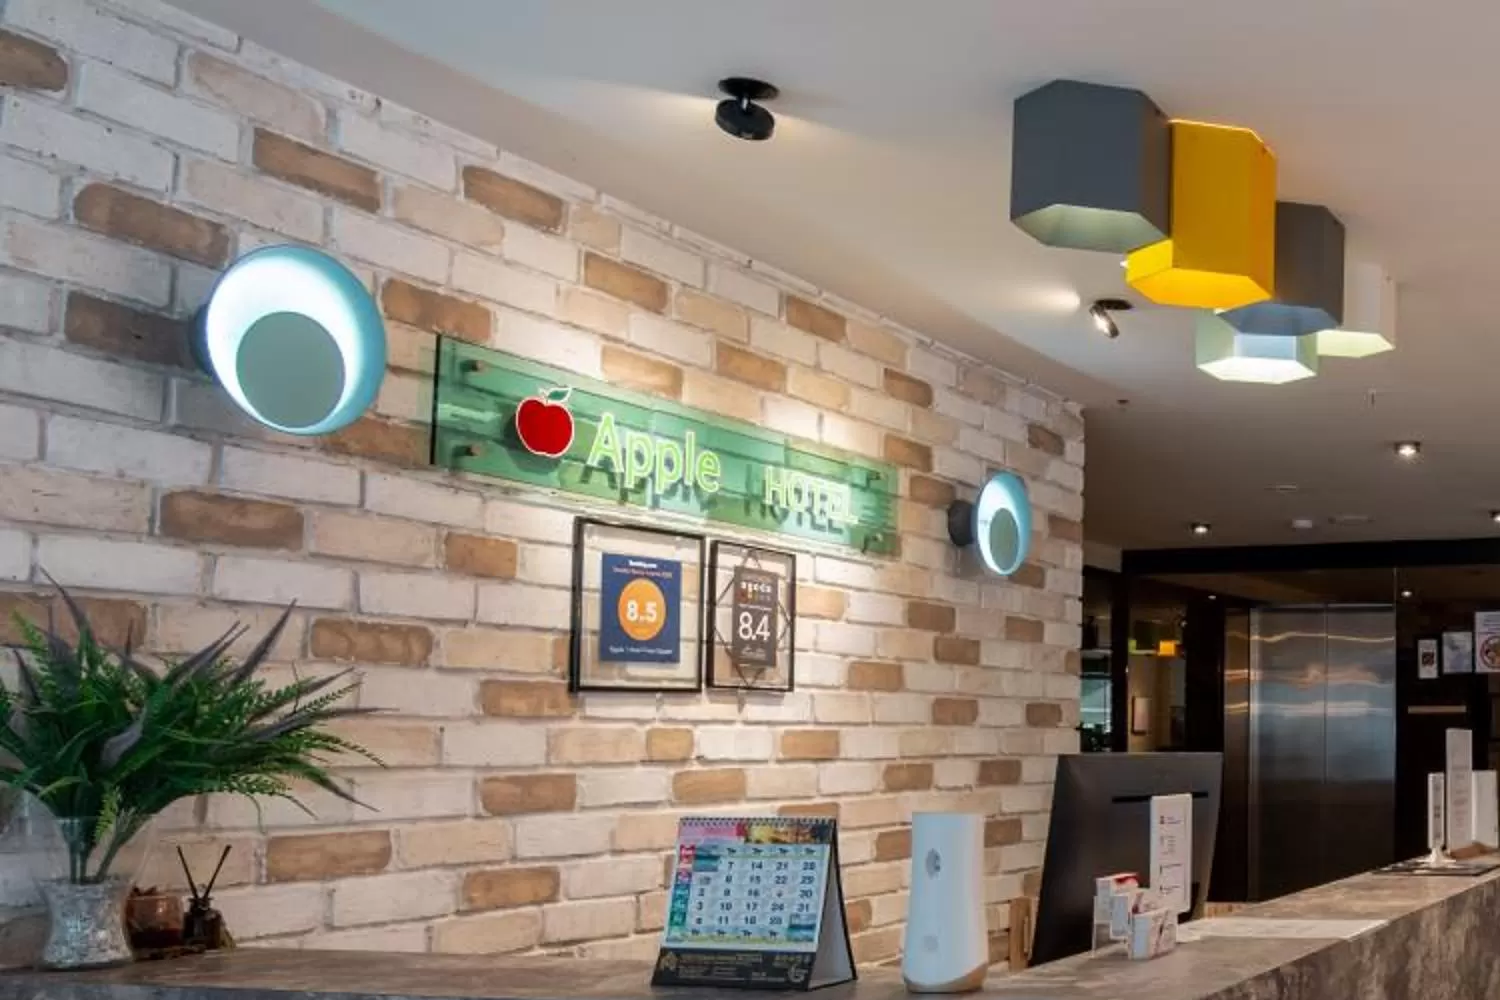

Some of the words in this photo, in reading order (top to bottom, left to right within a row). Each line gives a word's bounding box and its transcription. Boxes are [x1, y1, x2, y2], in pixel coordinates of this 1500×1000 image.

[586, 411, 721, 494] Apple
[764, 465, 859, 524] HOTEL
[626, 599, 657, 623] 8.5
[739, 611, 771, 641] 8.4
